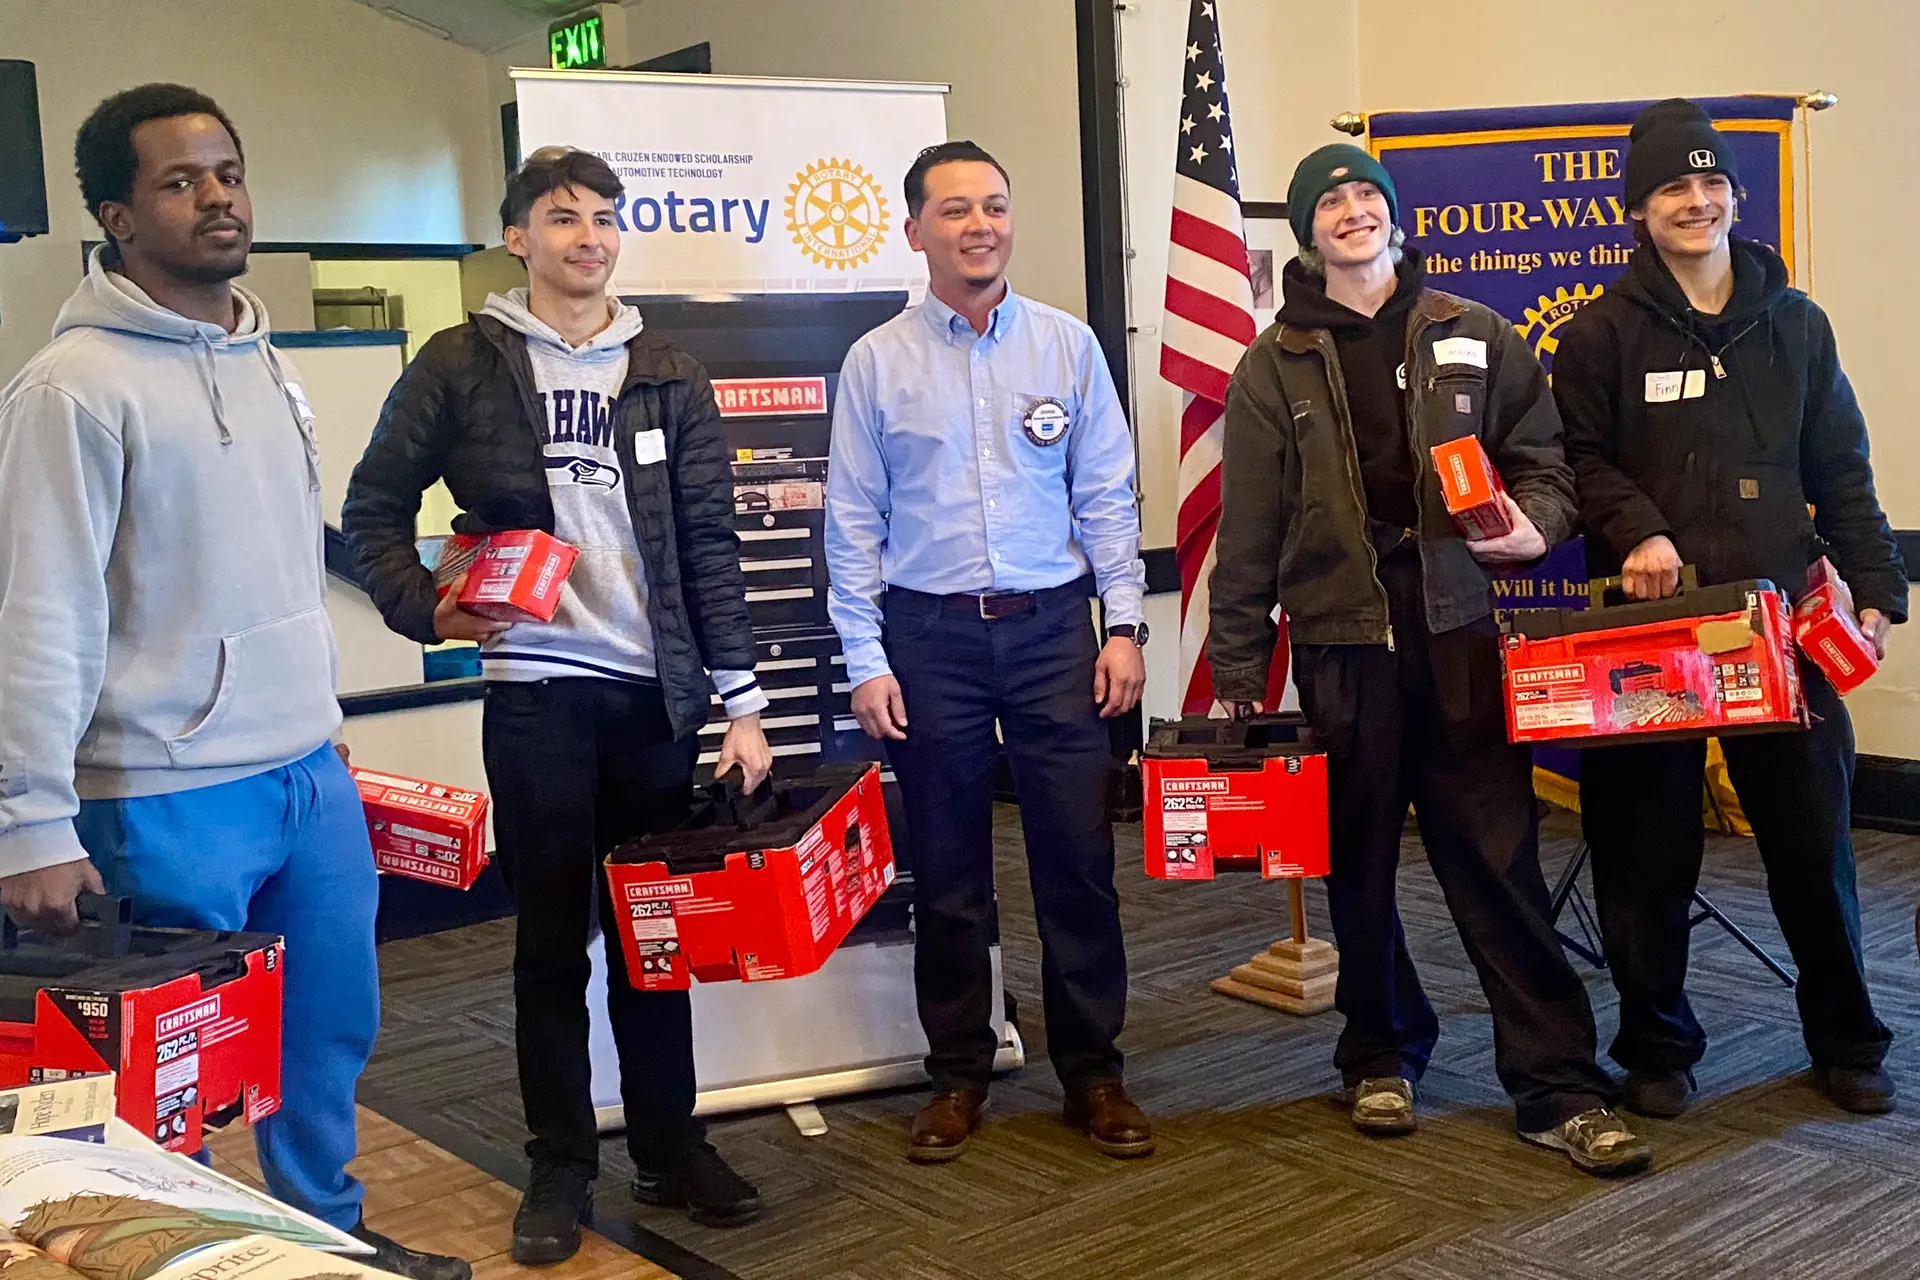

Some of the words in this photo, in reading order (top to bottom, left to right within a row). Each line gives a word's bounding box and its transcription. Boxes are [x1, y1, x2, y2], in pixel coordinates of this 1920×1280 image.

[552, 18, 599, 69] EXIT
[615, 152, 649, 162] CRUZEN
[652, 153, 693, 163] ENDOWED
[695, 154, 753, 164] SCHOLARSHIP
[1535, 149, 1621, 182] THE
[668, 168, 723, 179] TECHNOLOGY
[813, 169, 857, 182] ROTARY
[1413, 196, 1627, 238] FOUR-WAY
[804, 230, 876, 258] INTERNATIONAL
[1426, 253, 1462, 275] the
[1470, 249, 1542, 275] things
[1549, 251, 1581, 267] we
[714, 387, 816, 408] RAFTSMAN
[1656, 383, 1678, 396] Finn
[536, 556, 557, 596] CRAFTSMAN
[1492, 579, 1534, 597] Will
[1541, 579, 1556, 596] it
[1823, 640, 1852, 674] CRAFTSMAN
[1517, 668, 1579, 683] CRAFTSMAN
[1166, 781, 1224, 791] CRAFTSMAN
[389, 793, 465, 815] CRAFTSMAN
[1164, 797, 1186, 810] 262
[382, 855, 455, 880] CRAFTSMAN
[444, 851, 460, 864] 20
[629, 883, 688, 897] CRAFTSMAN
[630, 902, 653, 918] 262
[160, 1002, 216, 1033] CRAFTSMAN
[157, 1039, 179, 1064] 262
[181, 1246, 270, 1280] prite
